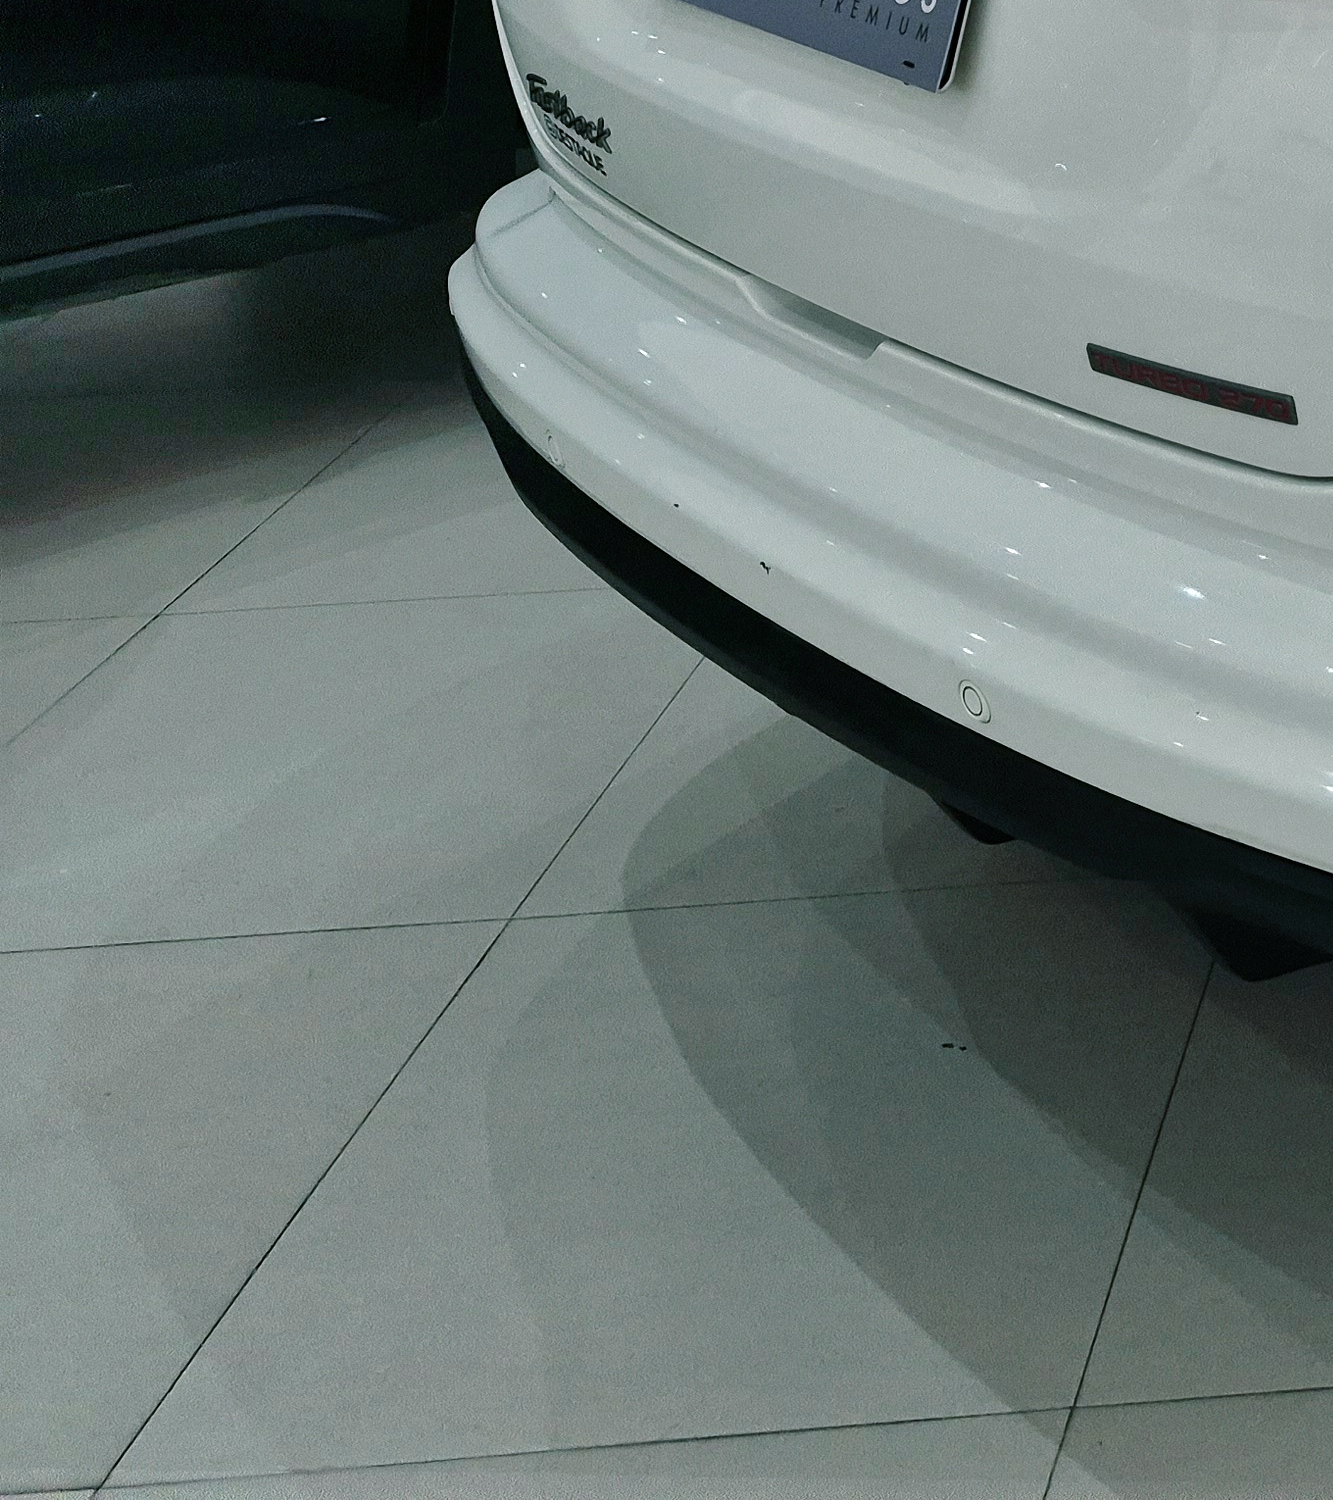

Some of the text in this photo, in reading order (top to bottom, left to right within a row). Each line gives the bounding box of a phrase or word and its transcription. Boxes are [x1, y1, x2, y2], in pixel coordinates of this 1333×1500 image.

[526, 73, 612, 155] Fastback
[1092, 352, 1292, 421] TURBO 270
